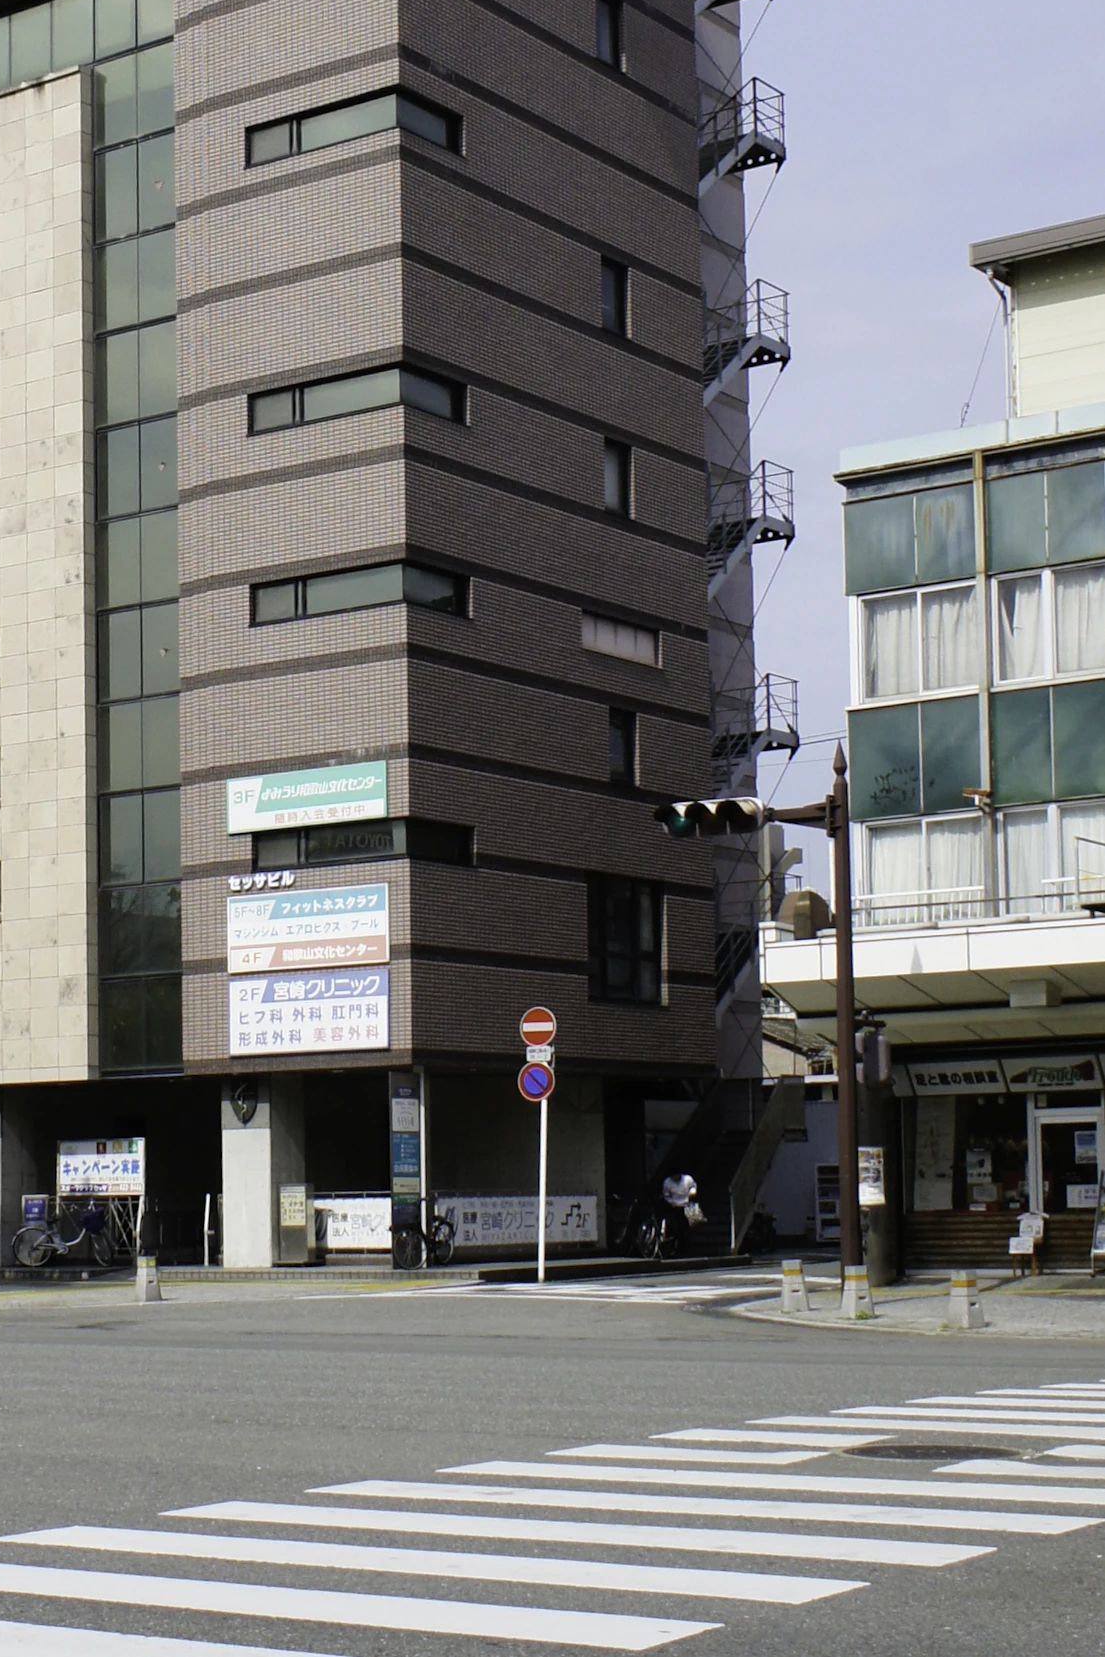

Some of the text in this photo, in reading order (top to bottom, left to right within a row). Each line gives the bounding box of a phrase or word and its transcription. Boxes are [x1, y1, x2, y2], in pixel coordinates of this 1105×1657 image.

[233, 789, 257, 804] 3F
[228, 870, 295, 891] セッサビル
[242, 951, 262, 964] 4F
[239, 975, 380, 1002] 2F 宮崎クリニック
[292, 1006, 322, 1022] 外科
[331, 1002, 379, 1020] 肛門科
[238, 1023, 379, 1047] 形成外科 美容外科
